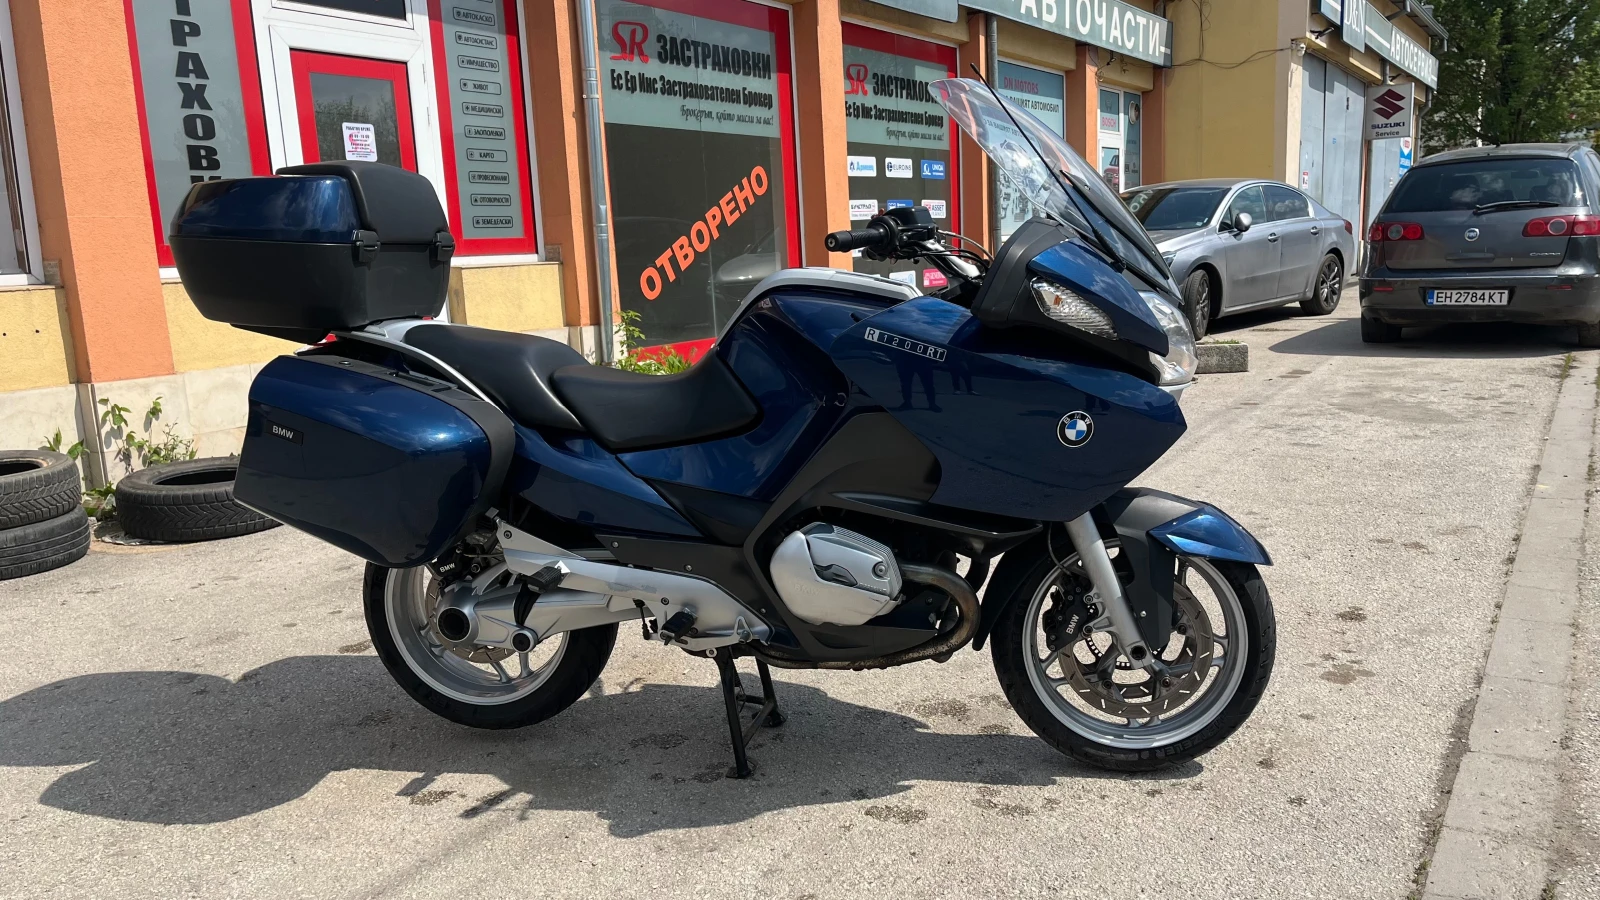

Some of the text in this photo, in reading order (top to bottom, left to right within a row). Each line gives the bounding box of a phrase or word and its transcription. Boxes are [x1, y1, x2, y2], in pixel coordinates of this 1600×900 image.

[462, 12, 492, 23] АВТОКАСКО
[656, 34, 772, 80] ЗАСТРАХОВКИ
[610, 69, 773, 110] Ес Ер Инс Застрахователен Брокер
[872, 72, 938, 104] ЗАСТРАХОВ
[1014, 79, 1039, 94] MOTORS
[1031, 100, 1060, 113] АВТОМОБИЛ
[1101, 116, 1117, 128] BOSCH
[1371, 121, 1405, 130] SUZUKI
[479, 151, 495, 159] КАРГО
[931, 204, 945, 212] ASSET
[640, 165, 768, 300] ОТВОРЕНО
[1062, 413, 1092, 425] BMW
[272, 425, 294, 439] BMW
[440, 562, 455, 573] BMW
[1065, 613, 1080, 635] BMW
